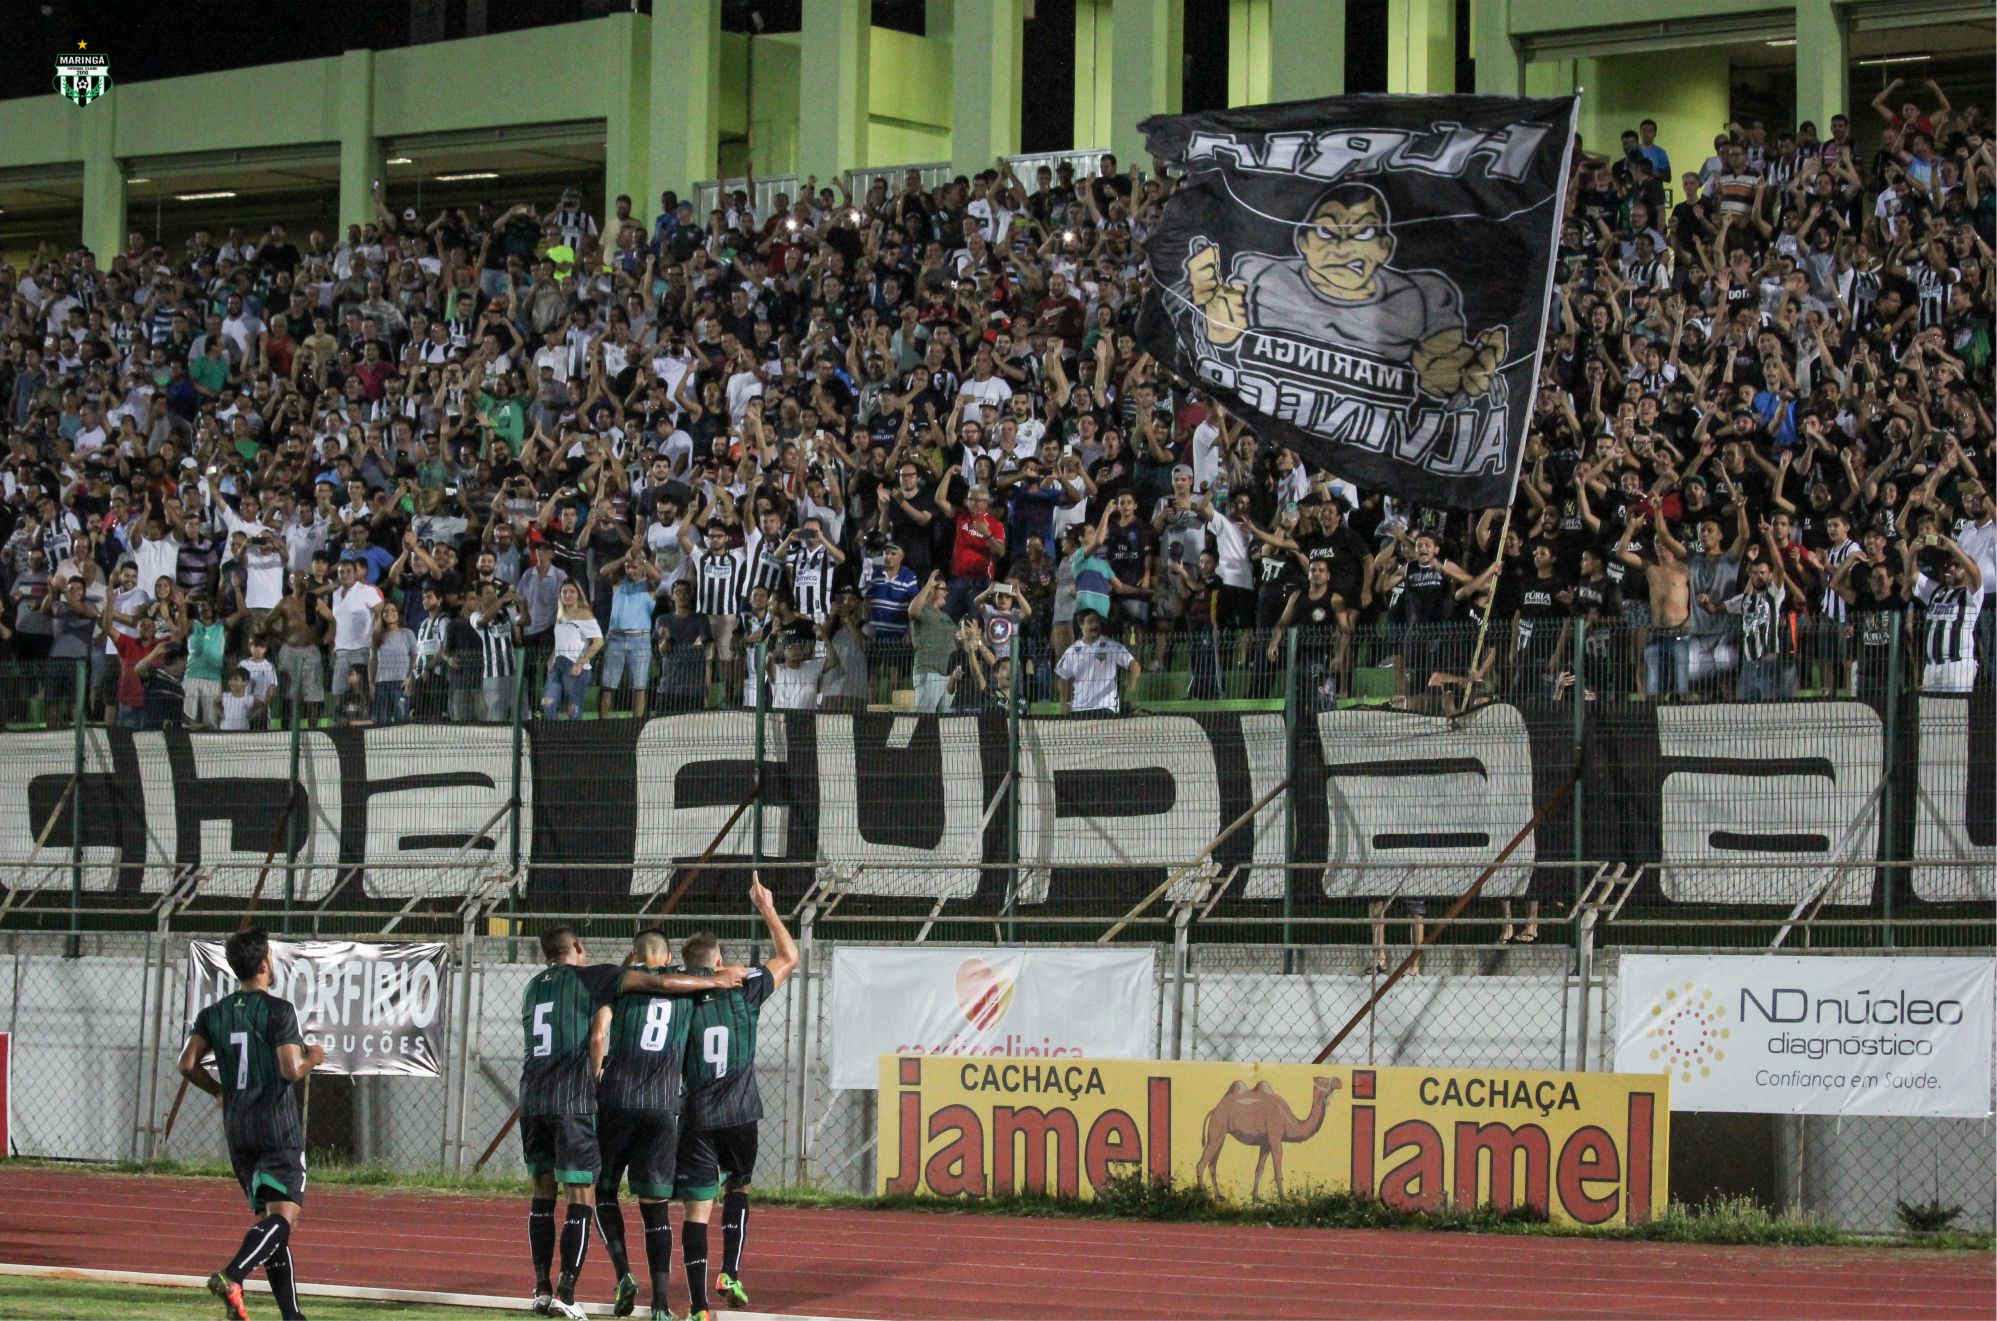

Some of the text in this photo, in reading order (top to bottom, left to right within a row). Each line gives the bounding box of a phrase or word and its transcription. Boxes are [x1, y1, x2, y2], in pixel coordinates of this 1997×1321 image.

[532, 1002, 554, 1056] 5
[640, 999, 672, 1051] 8
[1816, 990, 1963, 1025] núcleo
[230, 1032, 247, 1090] 7
[704, 1026, 728, 1078] 9
[1768, 1032, 1934, 1060] diagnóstico
[960, 1063, 1105, 1101] CACHAÇA
[1418, 1077, 1581, 1118] CACHAÇA
[1755, 1070, 1846, 1091] Confiança
[1884, 1072, 1942, 1090] Saúde.
[886, 1058, 1172, 1199] jamel
